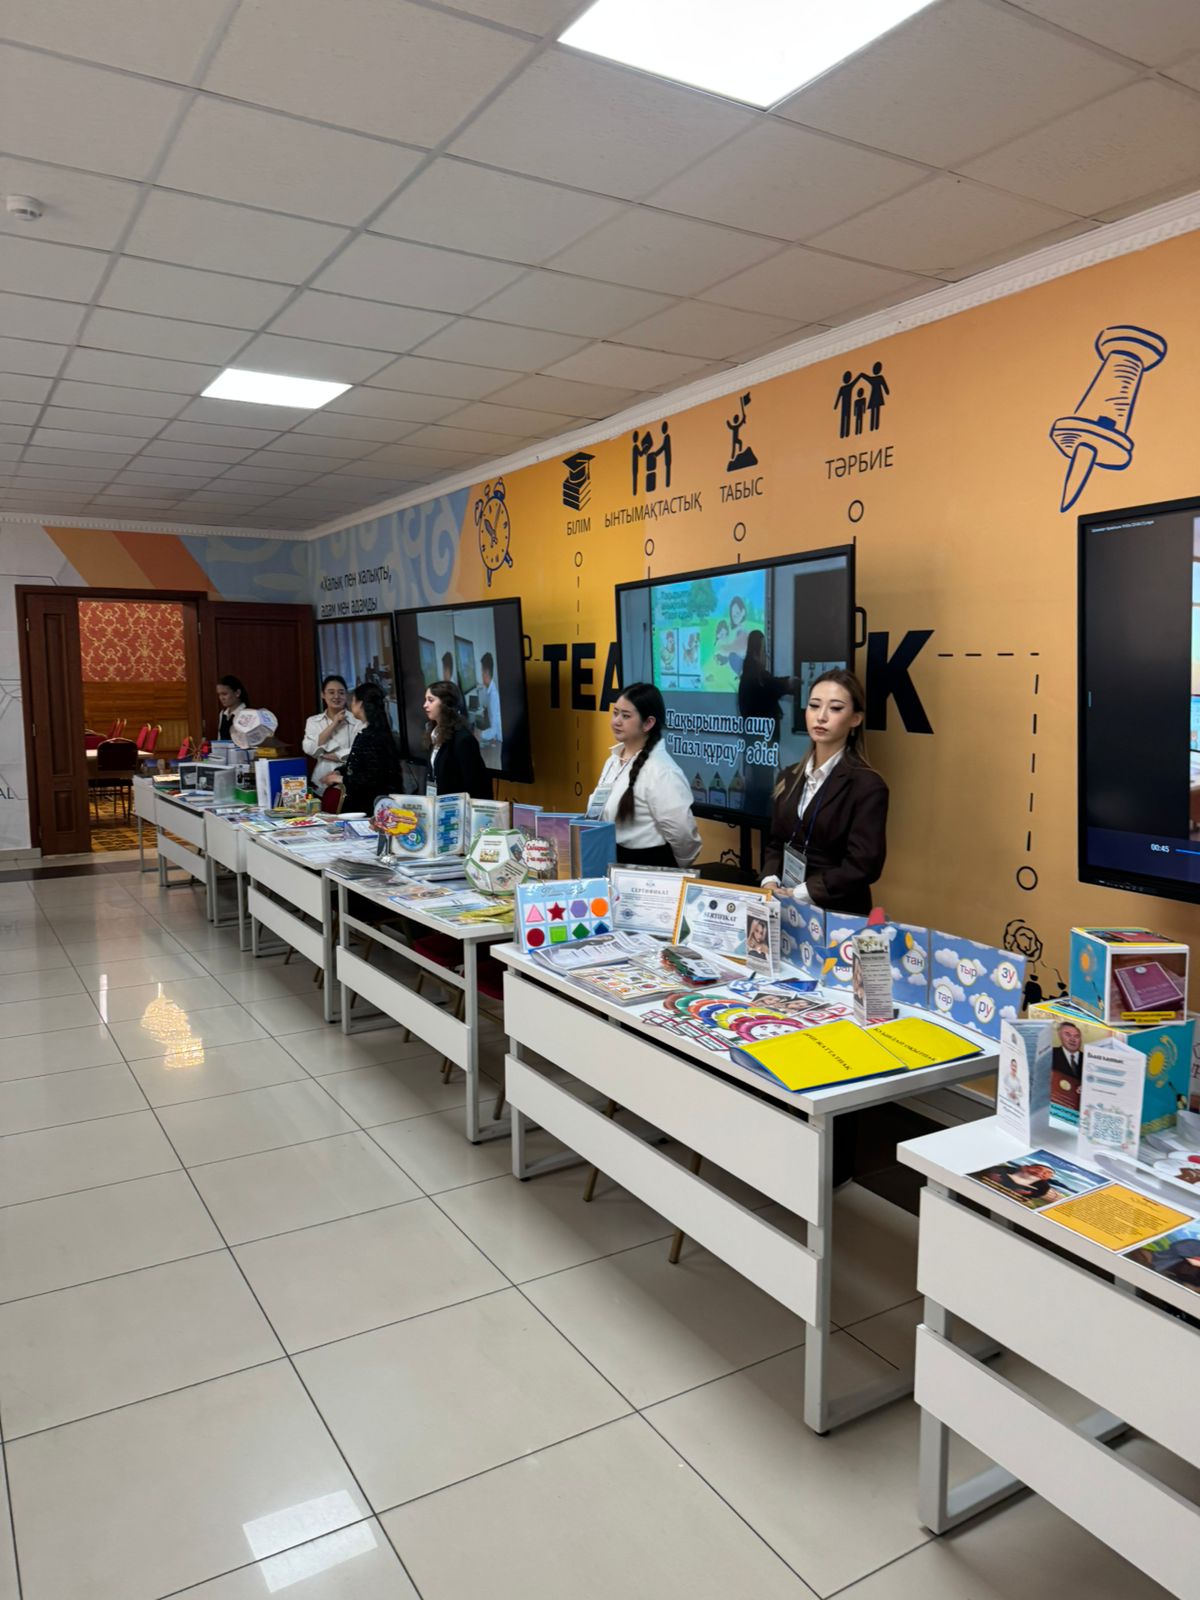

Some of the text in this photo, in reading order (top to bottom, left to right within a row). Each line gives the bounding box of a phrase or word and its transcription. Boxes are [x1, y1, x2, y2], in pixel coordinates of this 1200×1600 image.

[825, 446, 894, 479] ТӘРБИЕ
[720, 477, 764, 503] ТАБЫС
[604, 492, 703, 528] ЫНТЫМАҚТАСТЫҚ
[566, 518, 591, 536] БІЛІМ
[344, 572, 357, 588] пен
[666, 710, 776, 741] Тақырыпты ашу
[746, 742, 779, 767] әдісі
[1151, 843, 1170, 853] 00:45
[906, 955, 923, 968] тан
[960, 964, 977, 979] тыр
[1001, 967, 1015, 984] зу
[938, 991, 951, 1006] тар
[978, 1001, 992, 1018] ру
